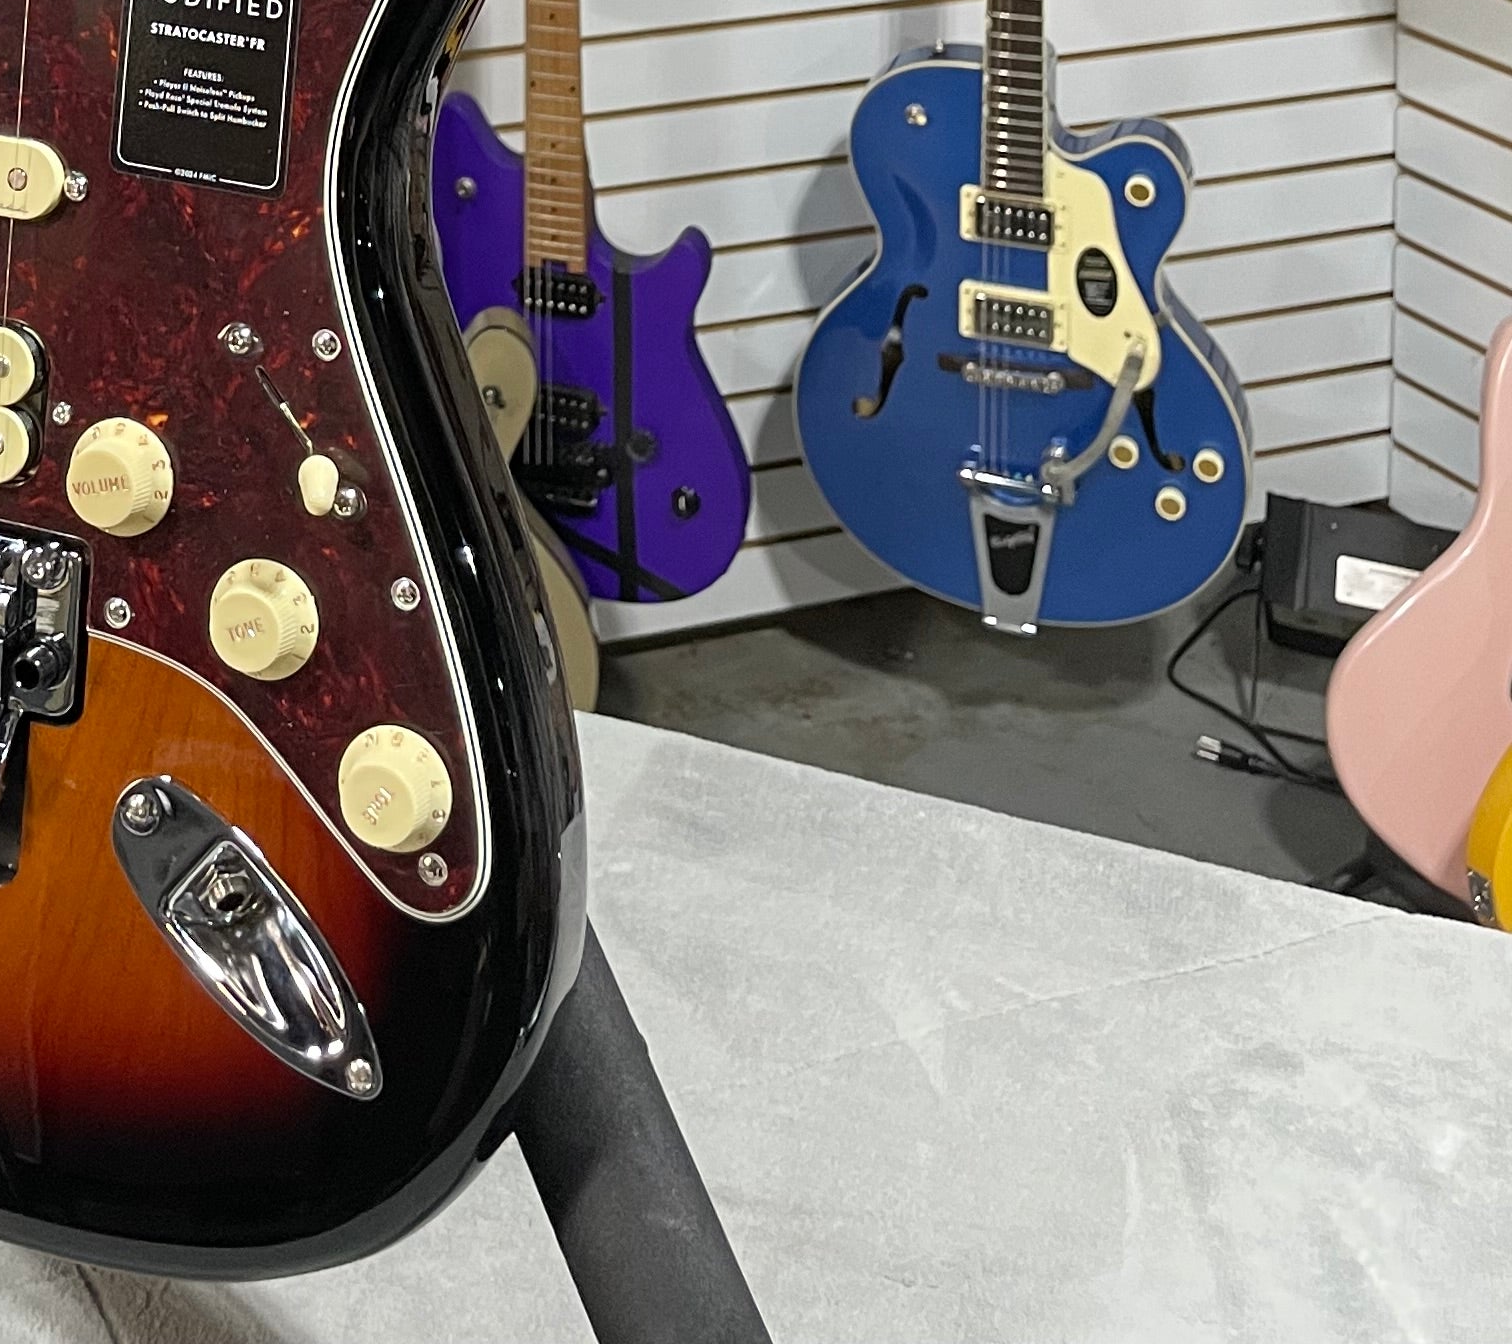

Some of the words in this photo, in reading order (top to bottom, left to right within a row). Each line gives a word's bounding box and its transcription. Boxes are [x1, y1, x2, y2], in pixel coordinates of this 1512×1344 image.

[250, 37, 265, 51] FR
[71, 474, 129, 497] VOLUME
[226, 616, 265, 644] TONE
